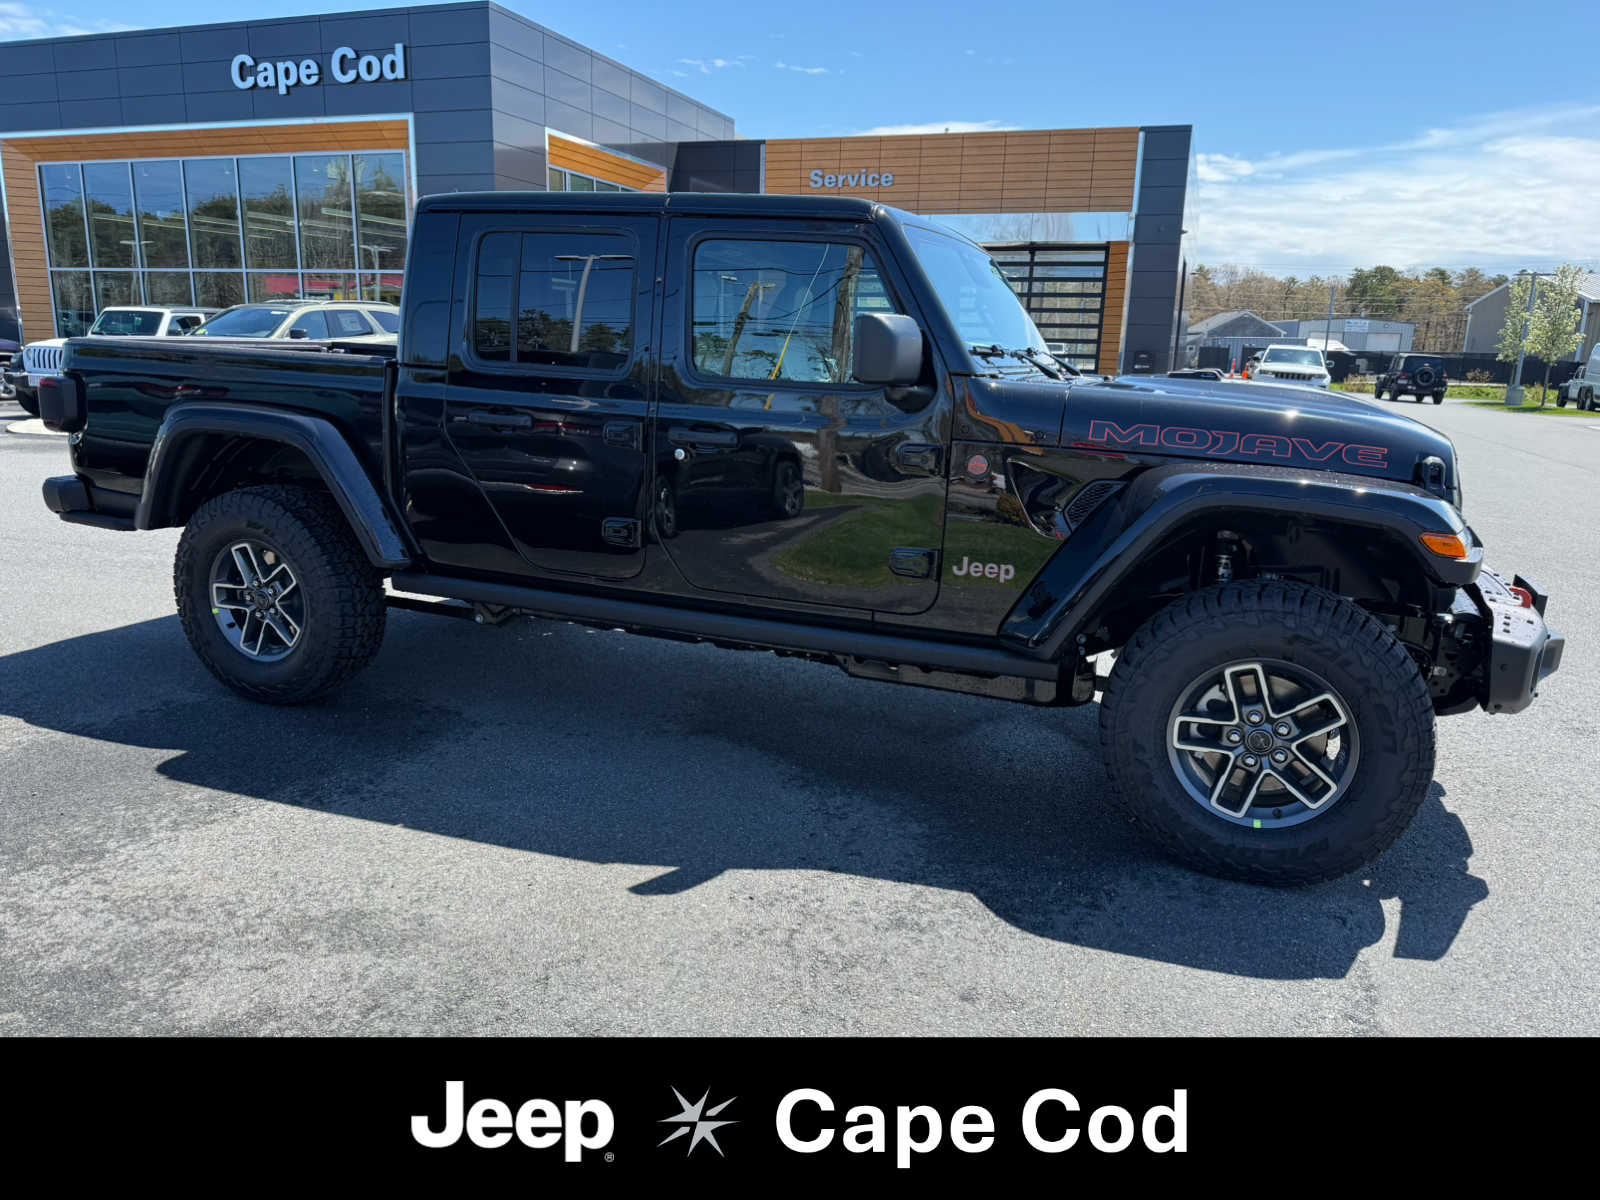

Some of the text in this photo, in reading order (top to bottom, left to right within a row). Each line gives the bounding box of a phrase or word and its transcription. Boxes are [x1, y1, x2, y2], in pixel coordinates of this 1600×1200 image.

[231, 43, 405, 95] Cape Cod
[809, 168, 894, 189] Service
[1089, 419, 1389, 470] MOJAVE
[952, 556, 1015, 584] Jeep
